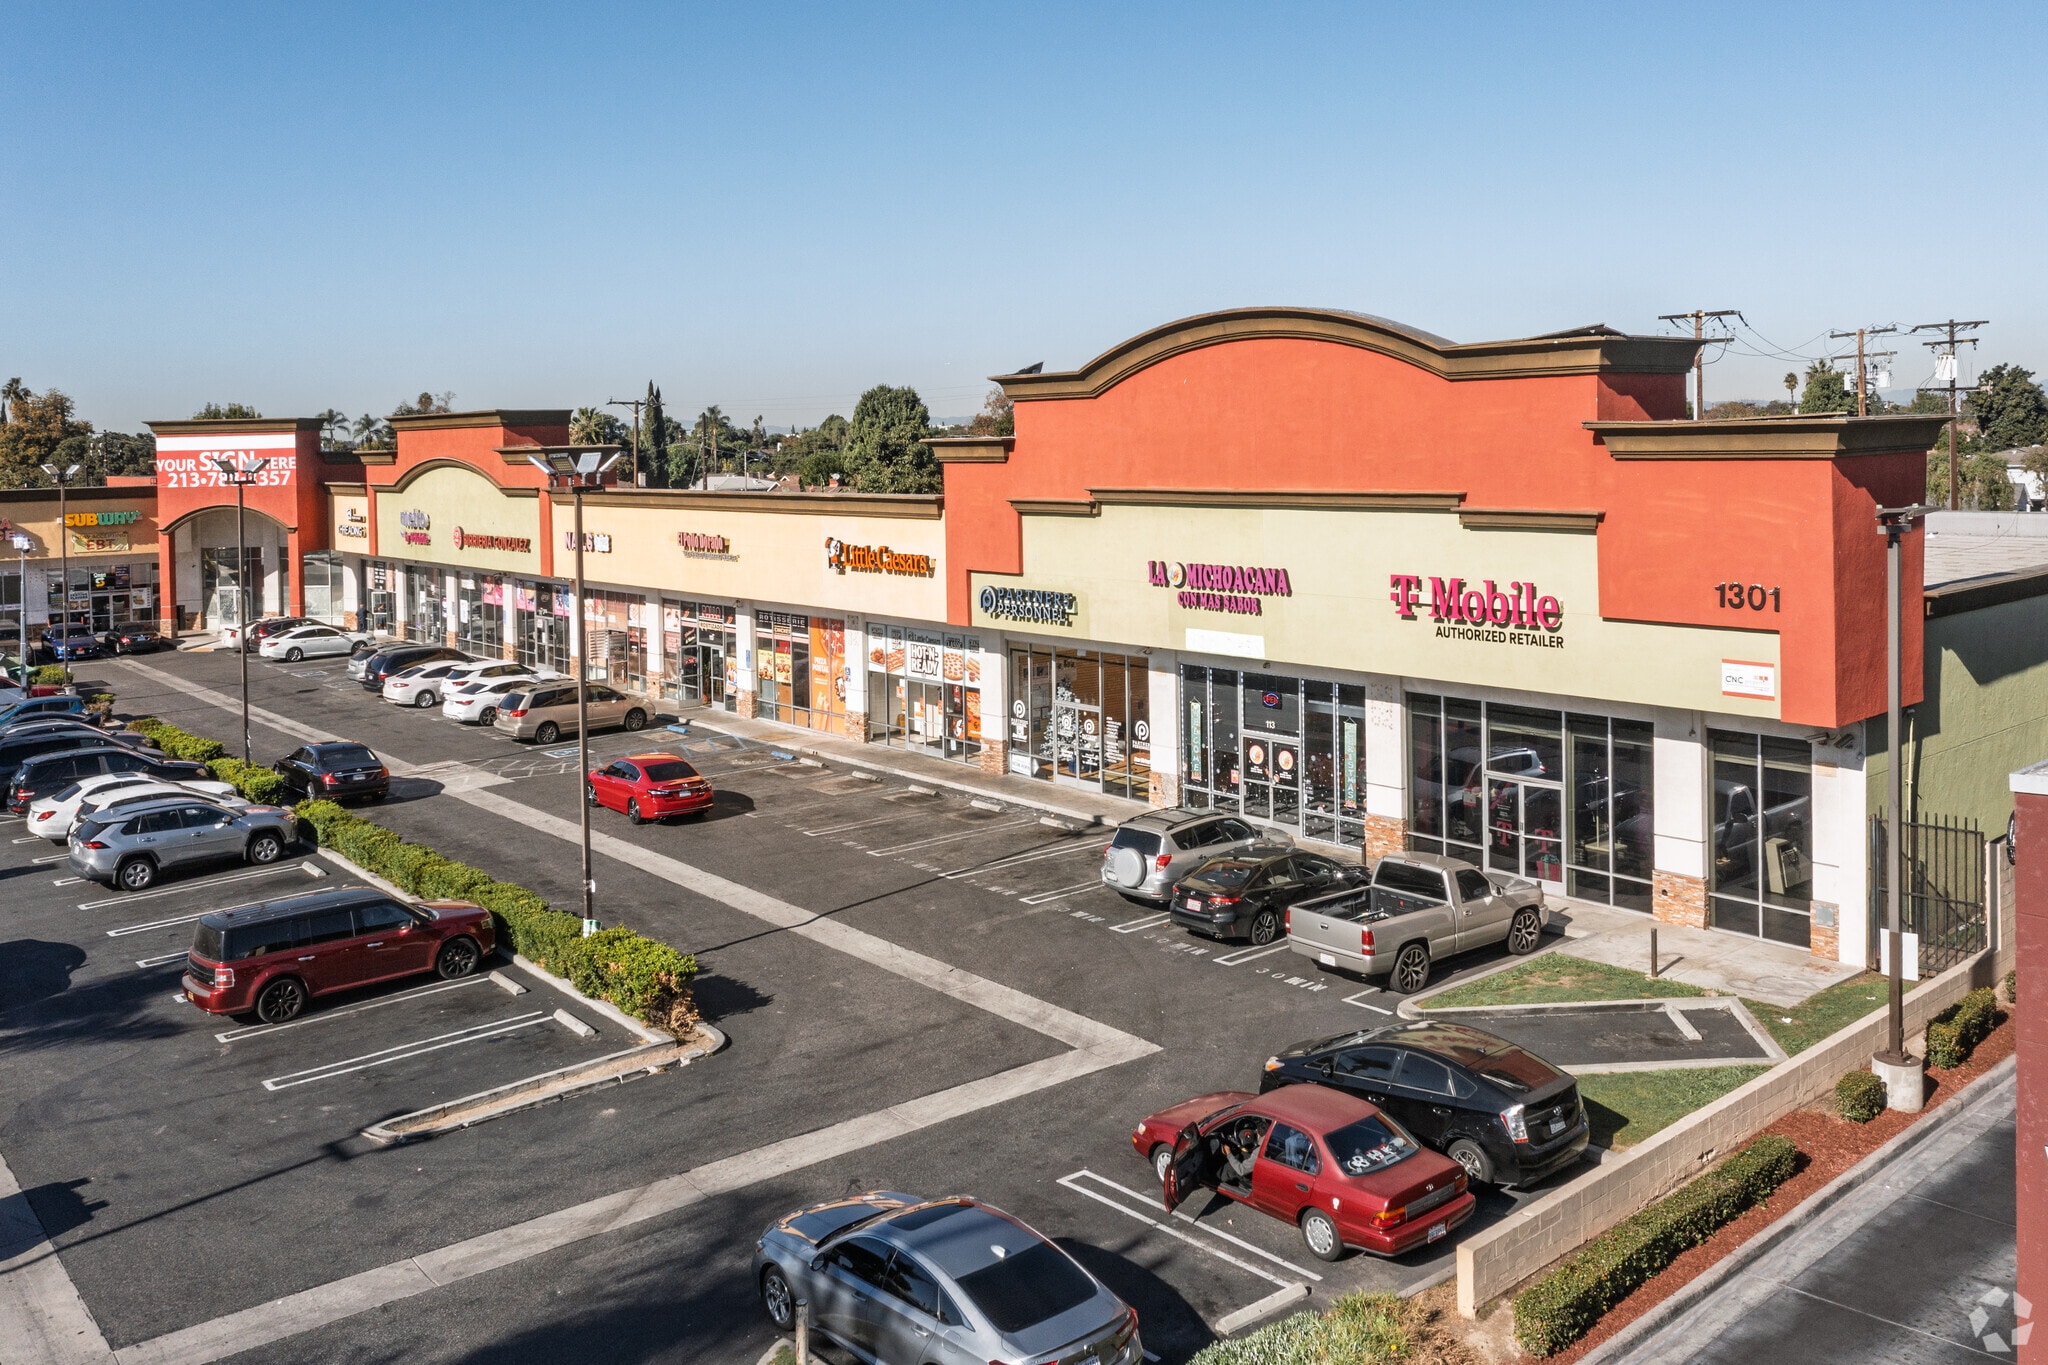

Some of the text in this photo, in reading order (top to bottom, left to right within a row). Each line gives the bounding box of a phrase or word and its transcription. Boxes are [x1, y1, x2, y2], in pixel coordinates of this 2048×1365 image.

[157, 459, 196, 472] YOUR
[65, 510, 140, 527] SUBWAY
[86, 538, 115, 550] EBT
[493, 536, 529, 551] GONZALEZ
[842, 543, 928, 573] Little Caesars
[1148, 561, 1289, 594] LA MICHOACANA
[997, 587, 1070, 607] PARTNERS
[1177, 591, 1259, 613] CON MAS SABOR
[1714, 582, 1780, 613] 1301
[997, 603, 1066, 622] PERSONNEL
[1435, 625, 1565, 649] AUTHORIZED RETAILER
[911, 658, 939, 676] READY
[1725, 675, 1744, 684] CNC
[1265, 720, 1276, 729] 113
